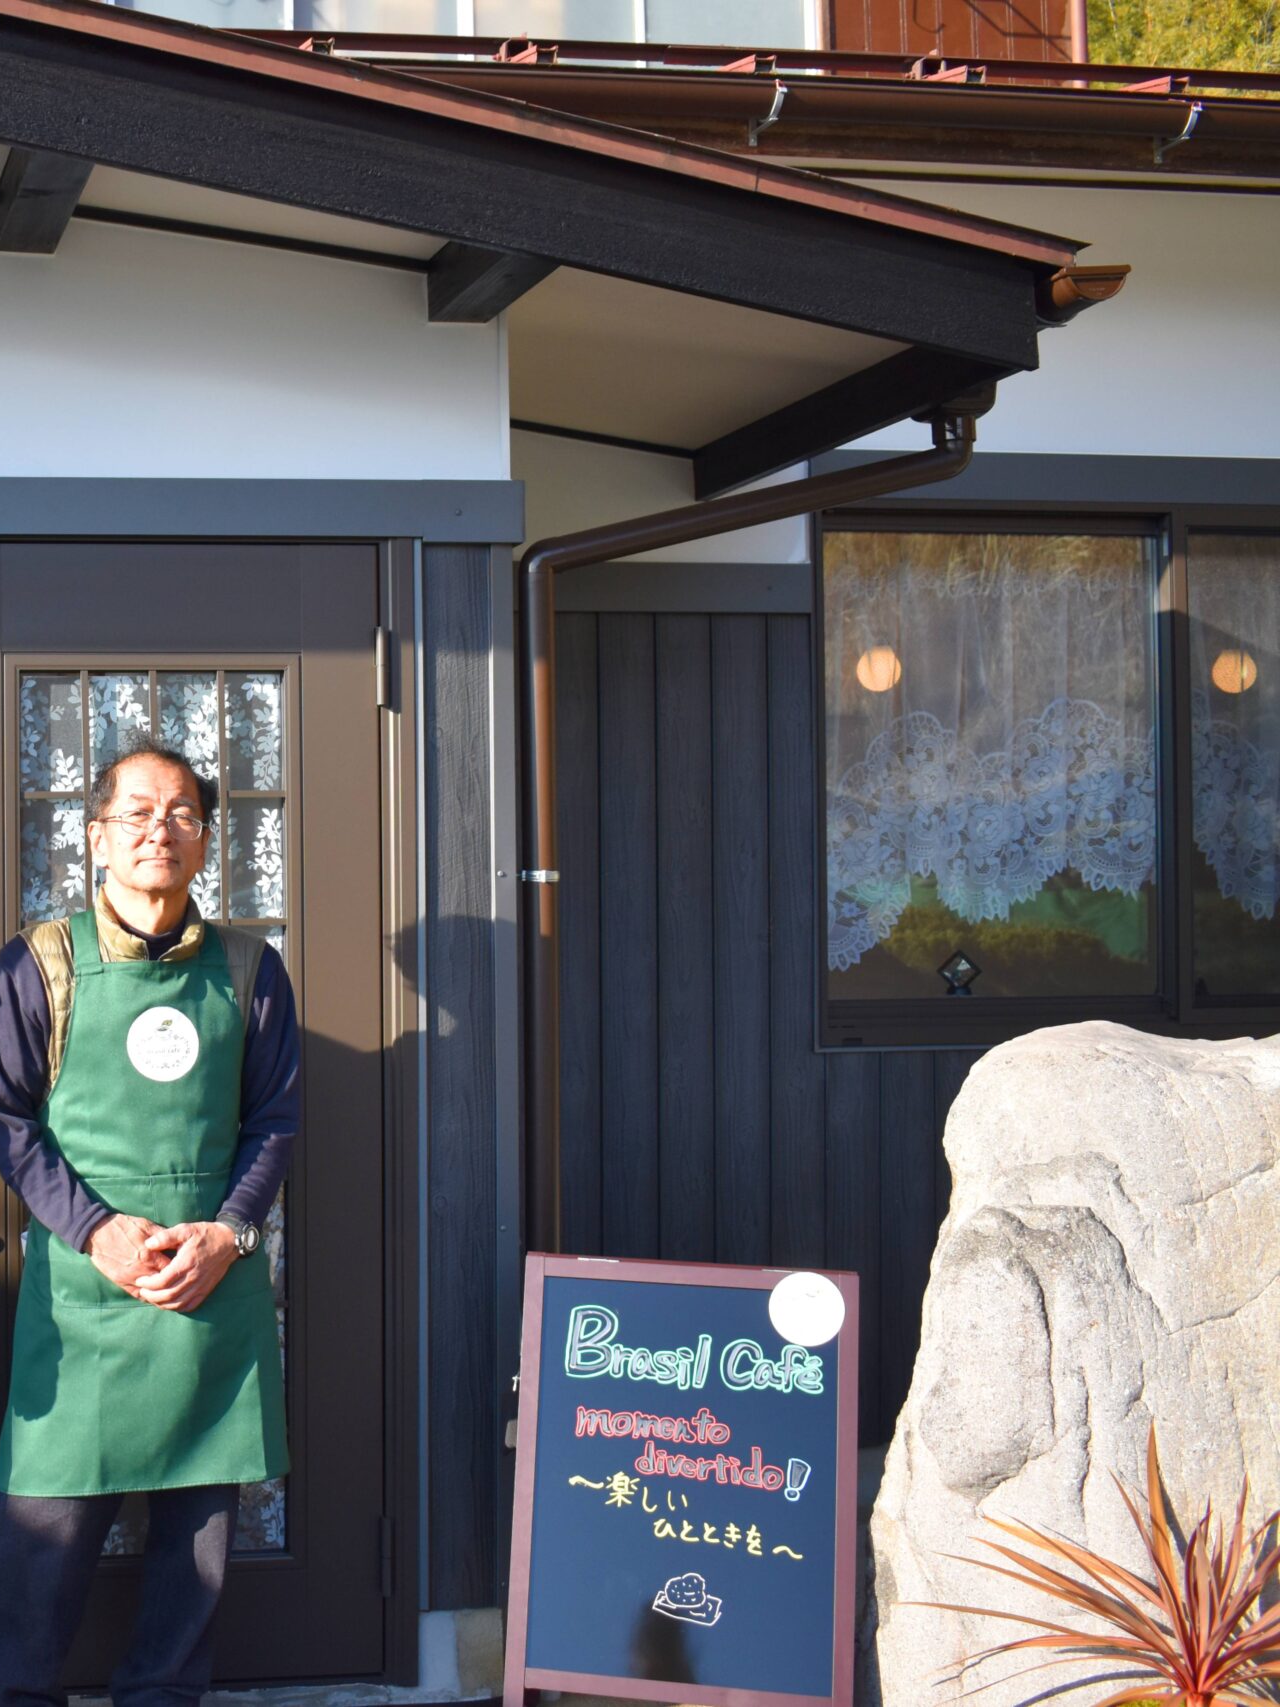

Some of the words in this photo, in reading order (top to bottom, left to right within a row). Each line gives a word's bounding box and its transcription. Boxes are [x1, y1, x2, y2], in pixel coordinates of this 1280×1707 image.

[565, 1304, 712, 1390] Brasil
[720, 1338, 824, 1394] Café
[575, 1406, 731, 1445] momento
[634, 1440, 812, 1502] divertido!
